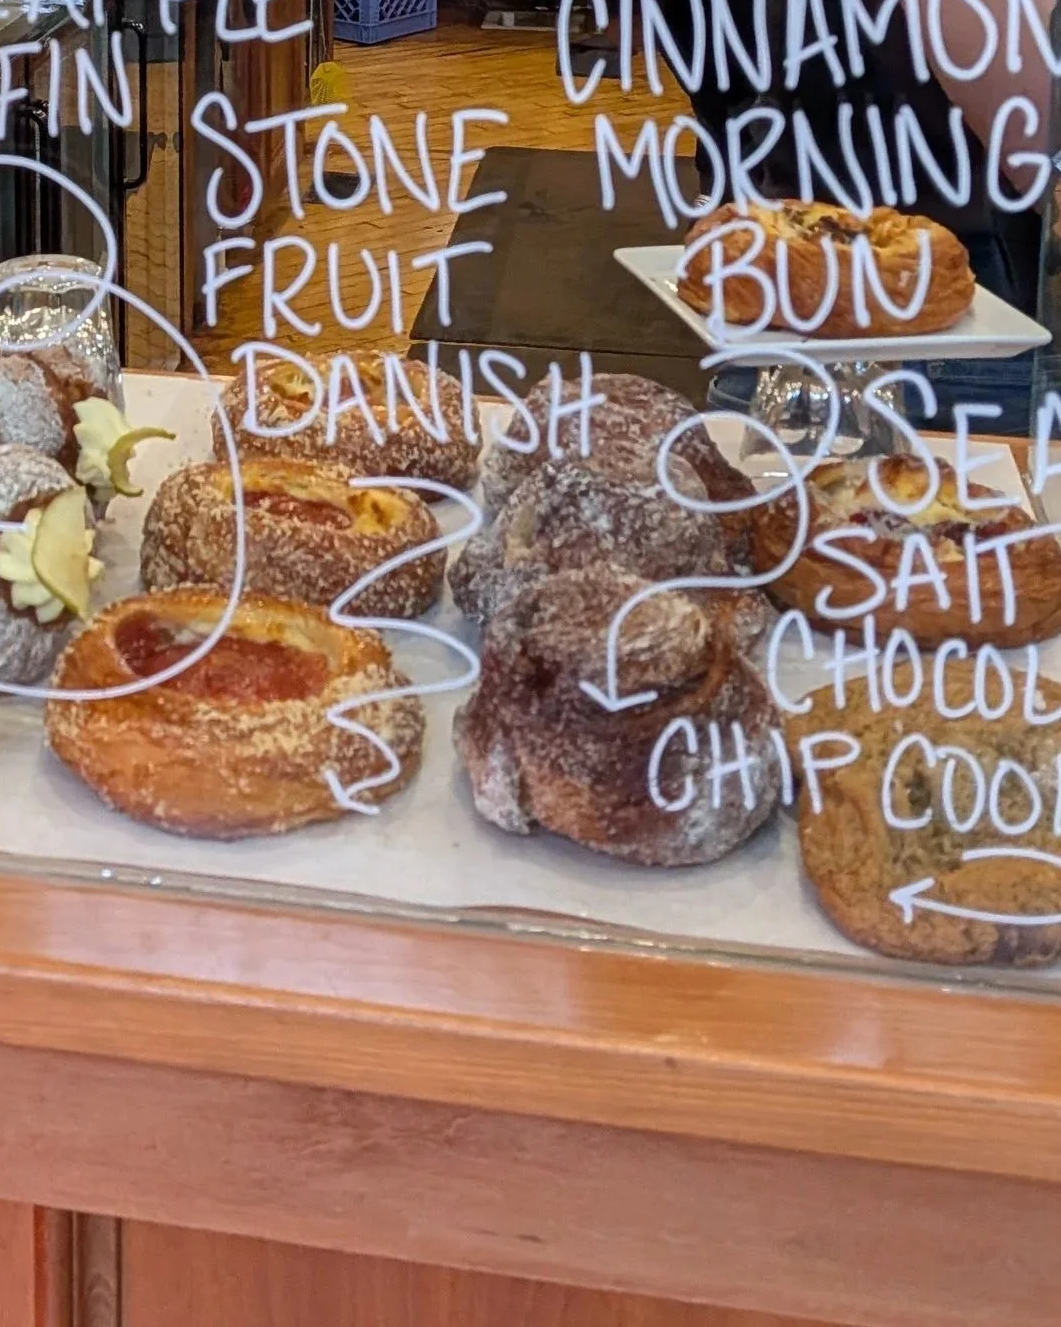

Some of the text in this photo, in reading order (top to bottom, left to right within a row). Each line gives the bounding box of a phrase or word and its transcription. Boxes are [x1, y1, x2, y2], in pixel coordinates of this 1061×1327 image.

[190, 91, 510, 229] STONE
[594, 96, 1052, 229] MORNING
[201, 235, 494, 337] FRUIT
[676, 220, 932, 341] BUN
[231, 341, 608, 460] DANISH
[649, 718, 1061, 836] CHIP COO
